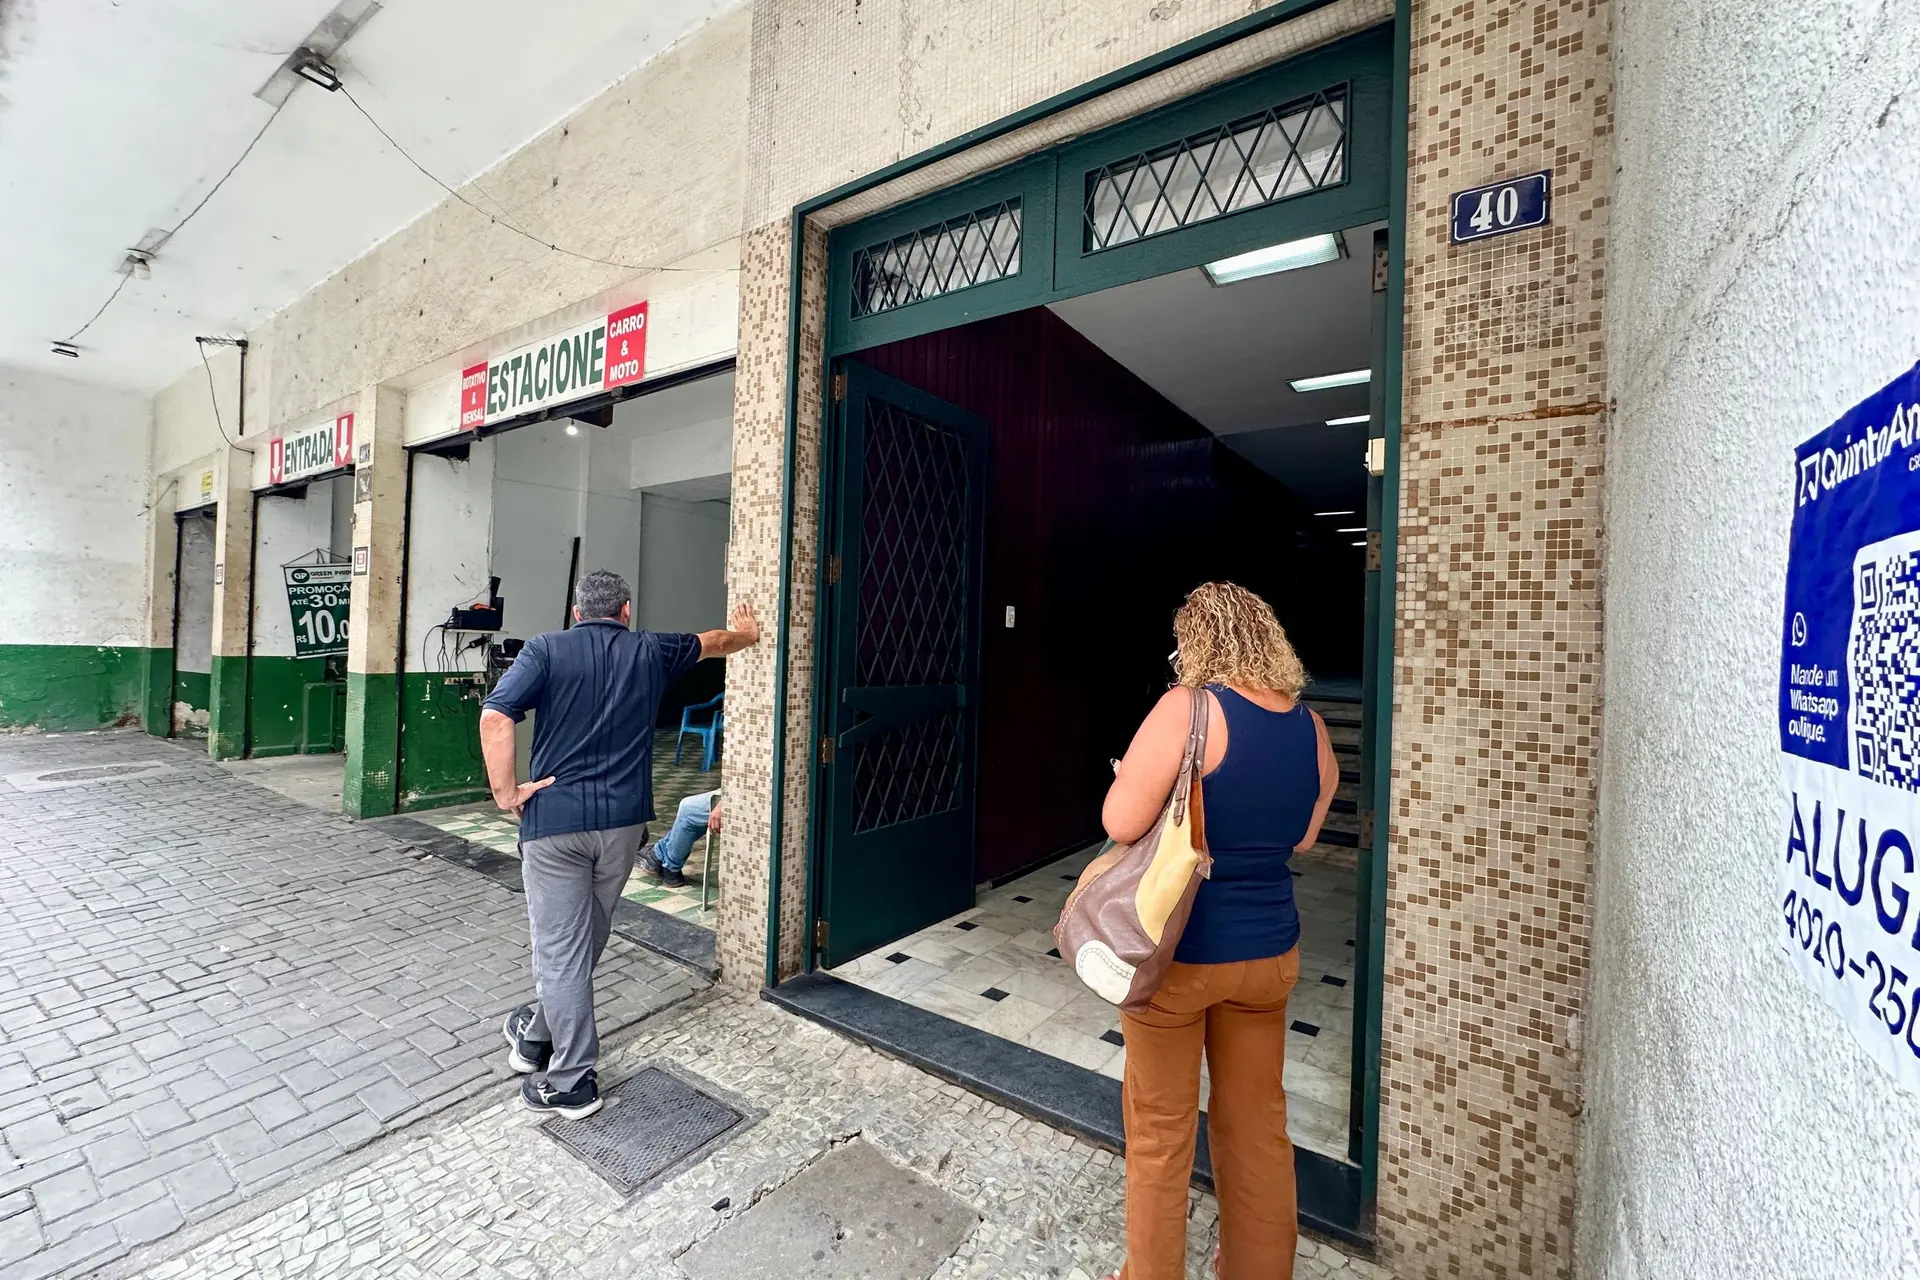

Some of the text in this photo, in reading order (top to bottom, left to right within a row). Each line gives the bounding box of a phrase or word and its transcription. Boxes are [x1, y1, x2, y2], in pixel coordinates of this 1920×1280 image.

[1470, 187, 1518, 231] 40
[609, 313, 645, 338] CARRO
[620, 340, 628, 357] &
[486, 326, 605, 416] ESTACIONE
[609, 359, 638, 382] MOTO
[462, 407, 484, 425] MENSAL
[284, 427, 333, 475] ENTRADA
[291, 598, 309, 606] ATÉ
[309, 594, 337, 607] 30
[296, 635, 308, 644] R$
[1786, 791, 1920, 951] ALUG
